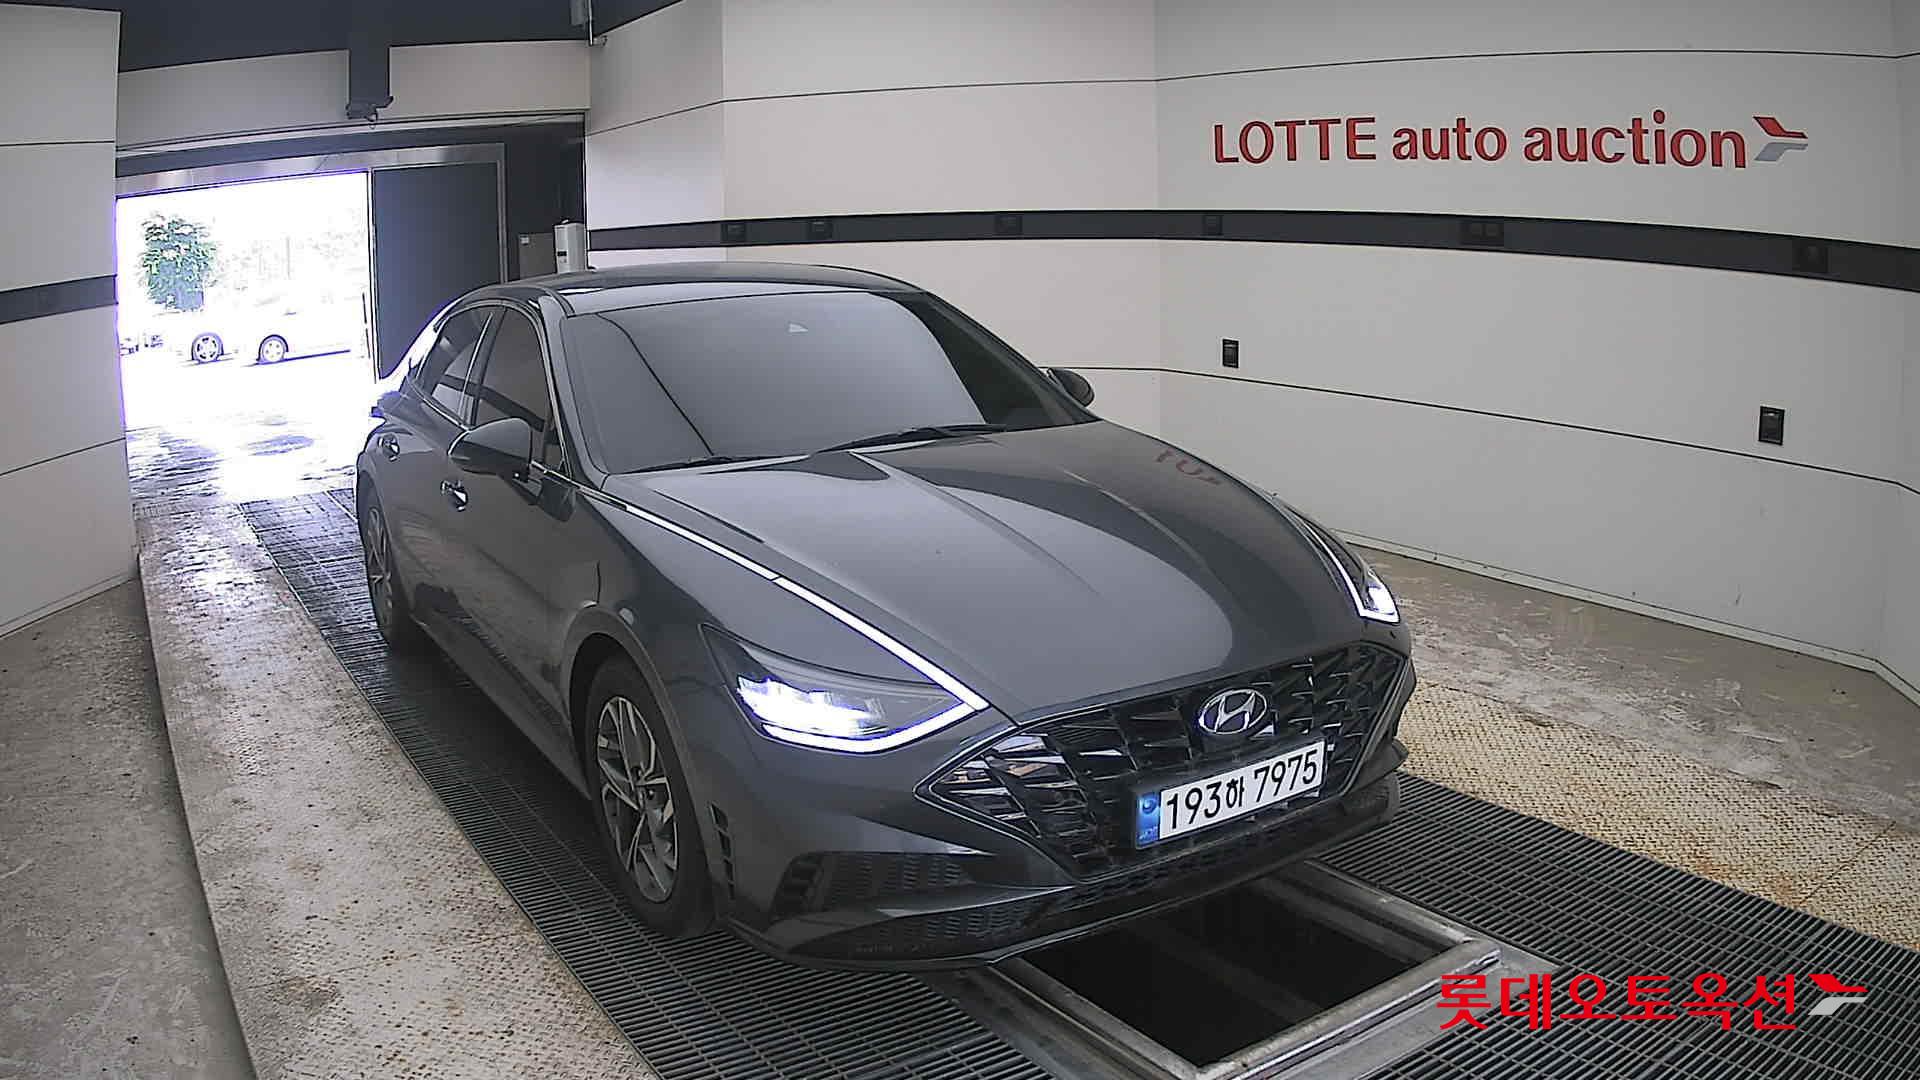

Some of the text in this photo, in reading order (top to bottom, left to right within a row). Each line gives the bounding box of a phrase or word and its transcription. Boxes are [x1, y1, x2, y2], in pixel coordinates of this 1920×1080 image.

[1213, 109, 1747, 169] LOTTE auto auction
[1167, 749, 1318, 829] 193하 7975
